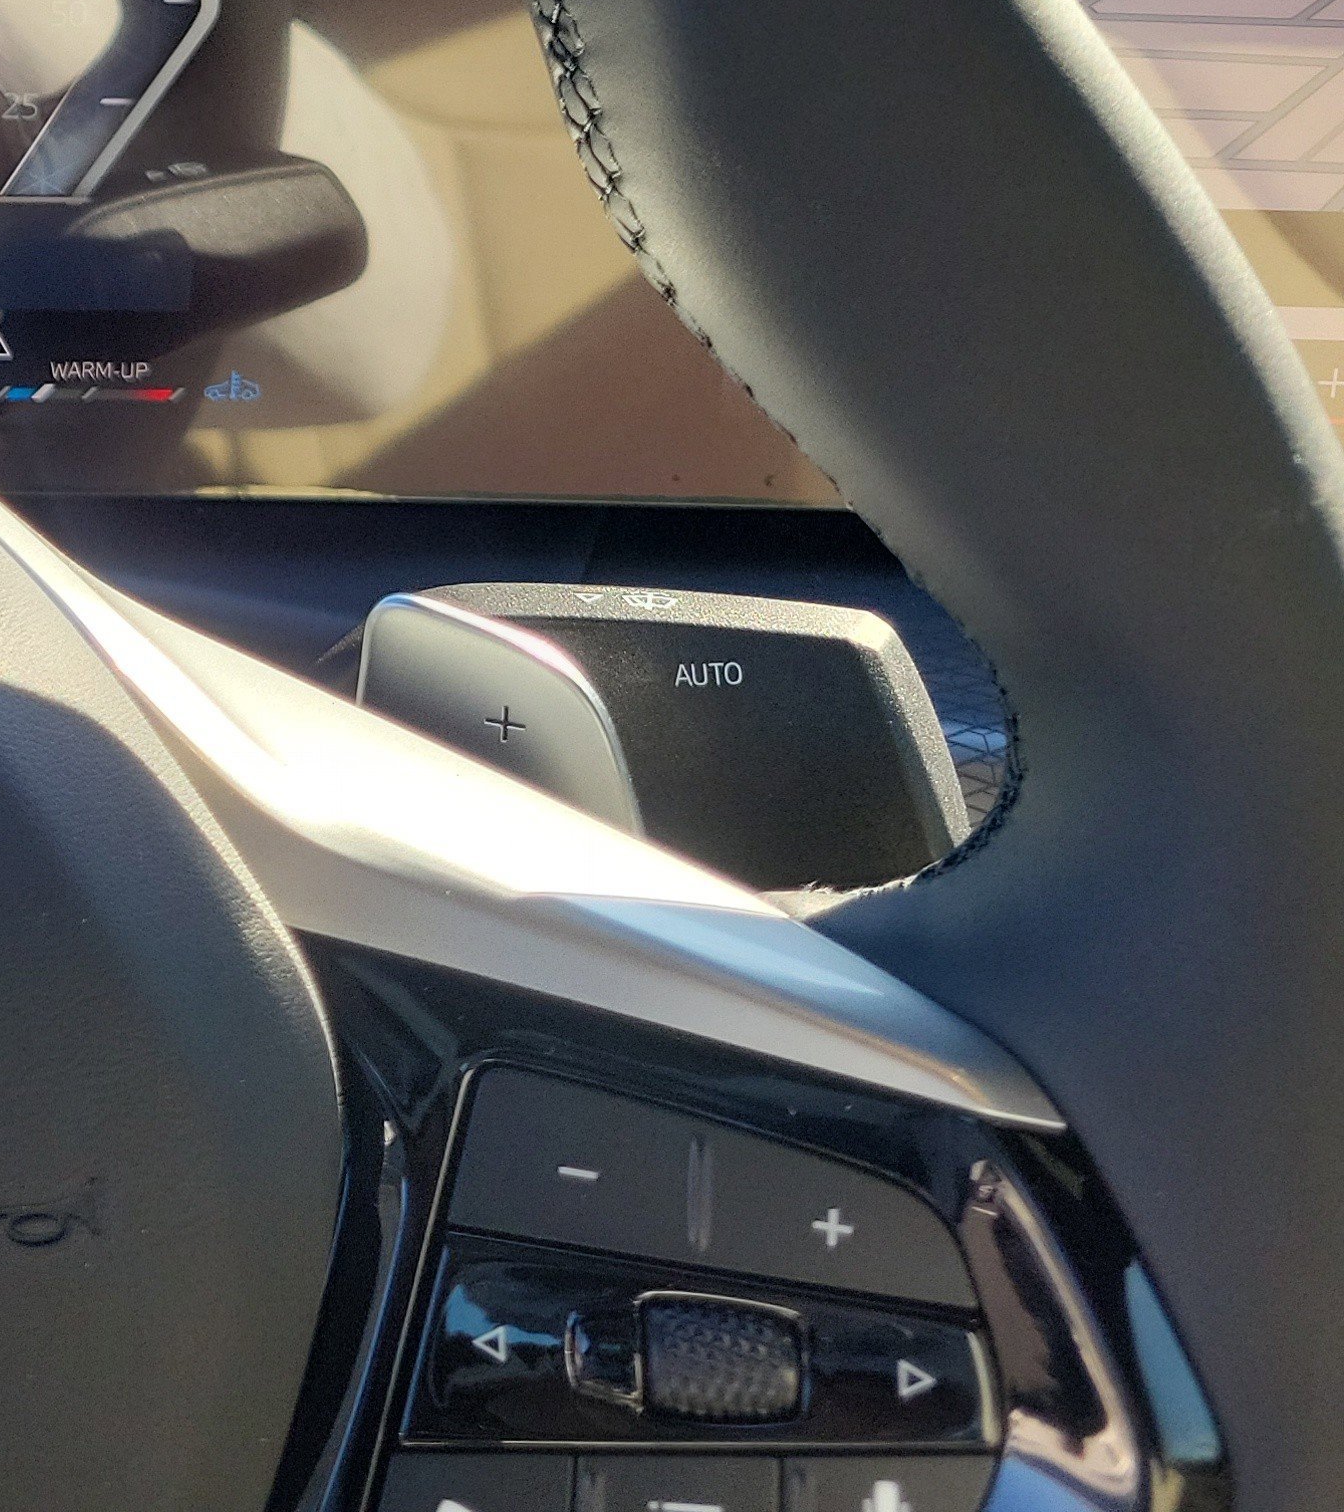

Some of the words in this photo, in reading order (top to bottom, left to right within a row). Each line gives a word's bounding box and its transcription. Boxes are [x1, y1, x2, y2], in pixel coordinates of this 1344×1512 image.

[1, 91, 39, 120] 25
[50, 360, 150, 380] WARM-UP
[674, 661, 743, 688] AUTO
